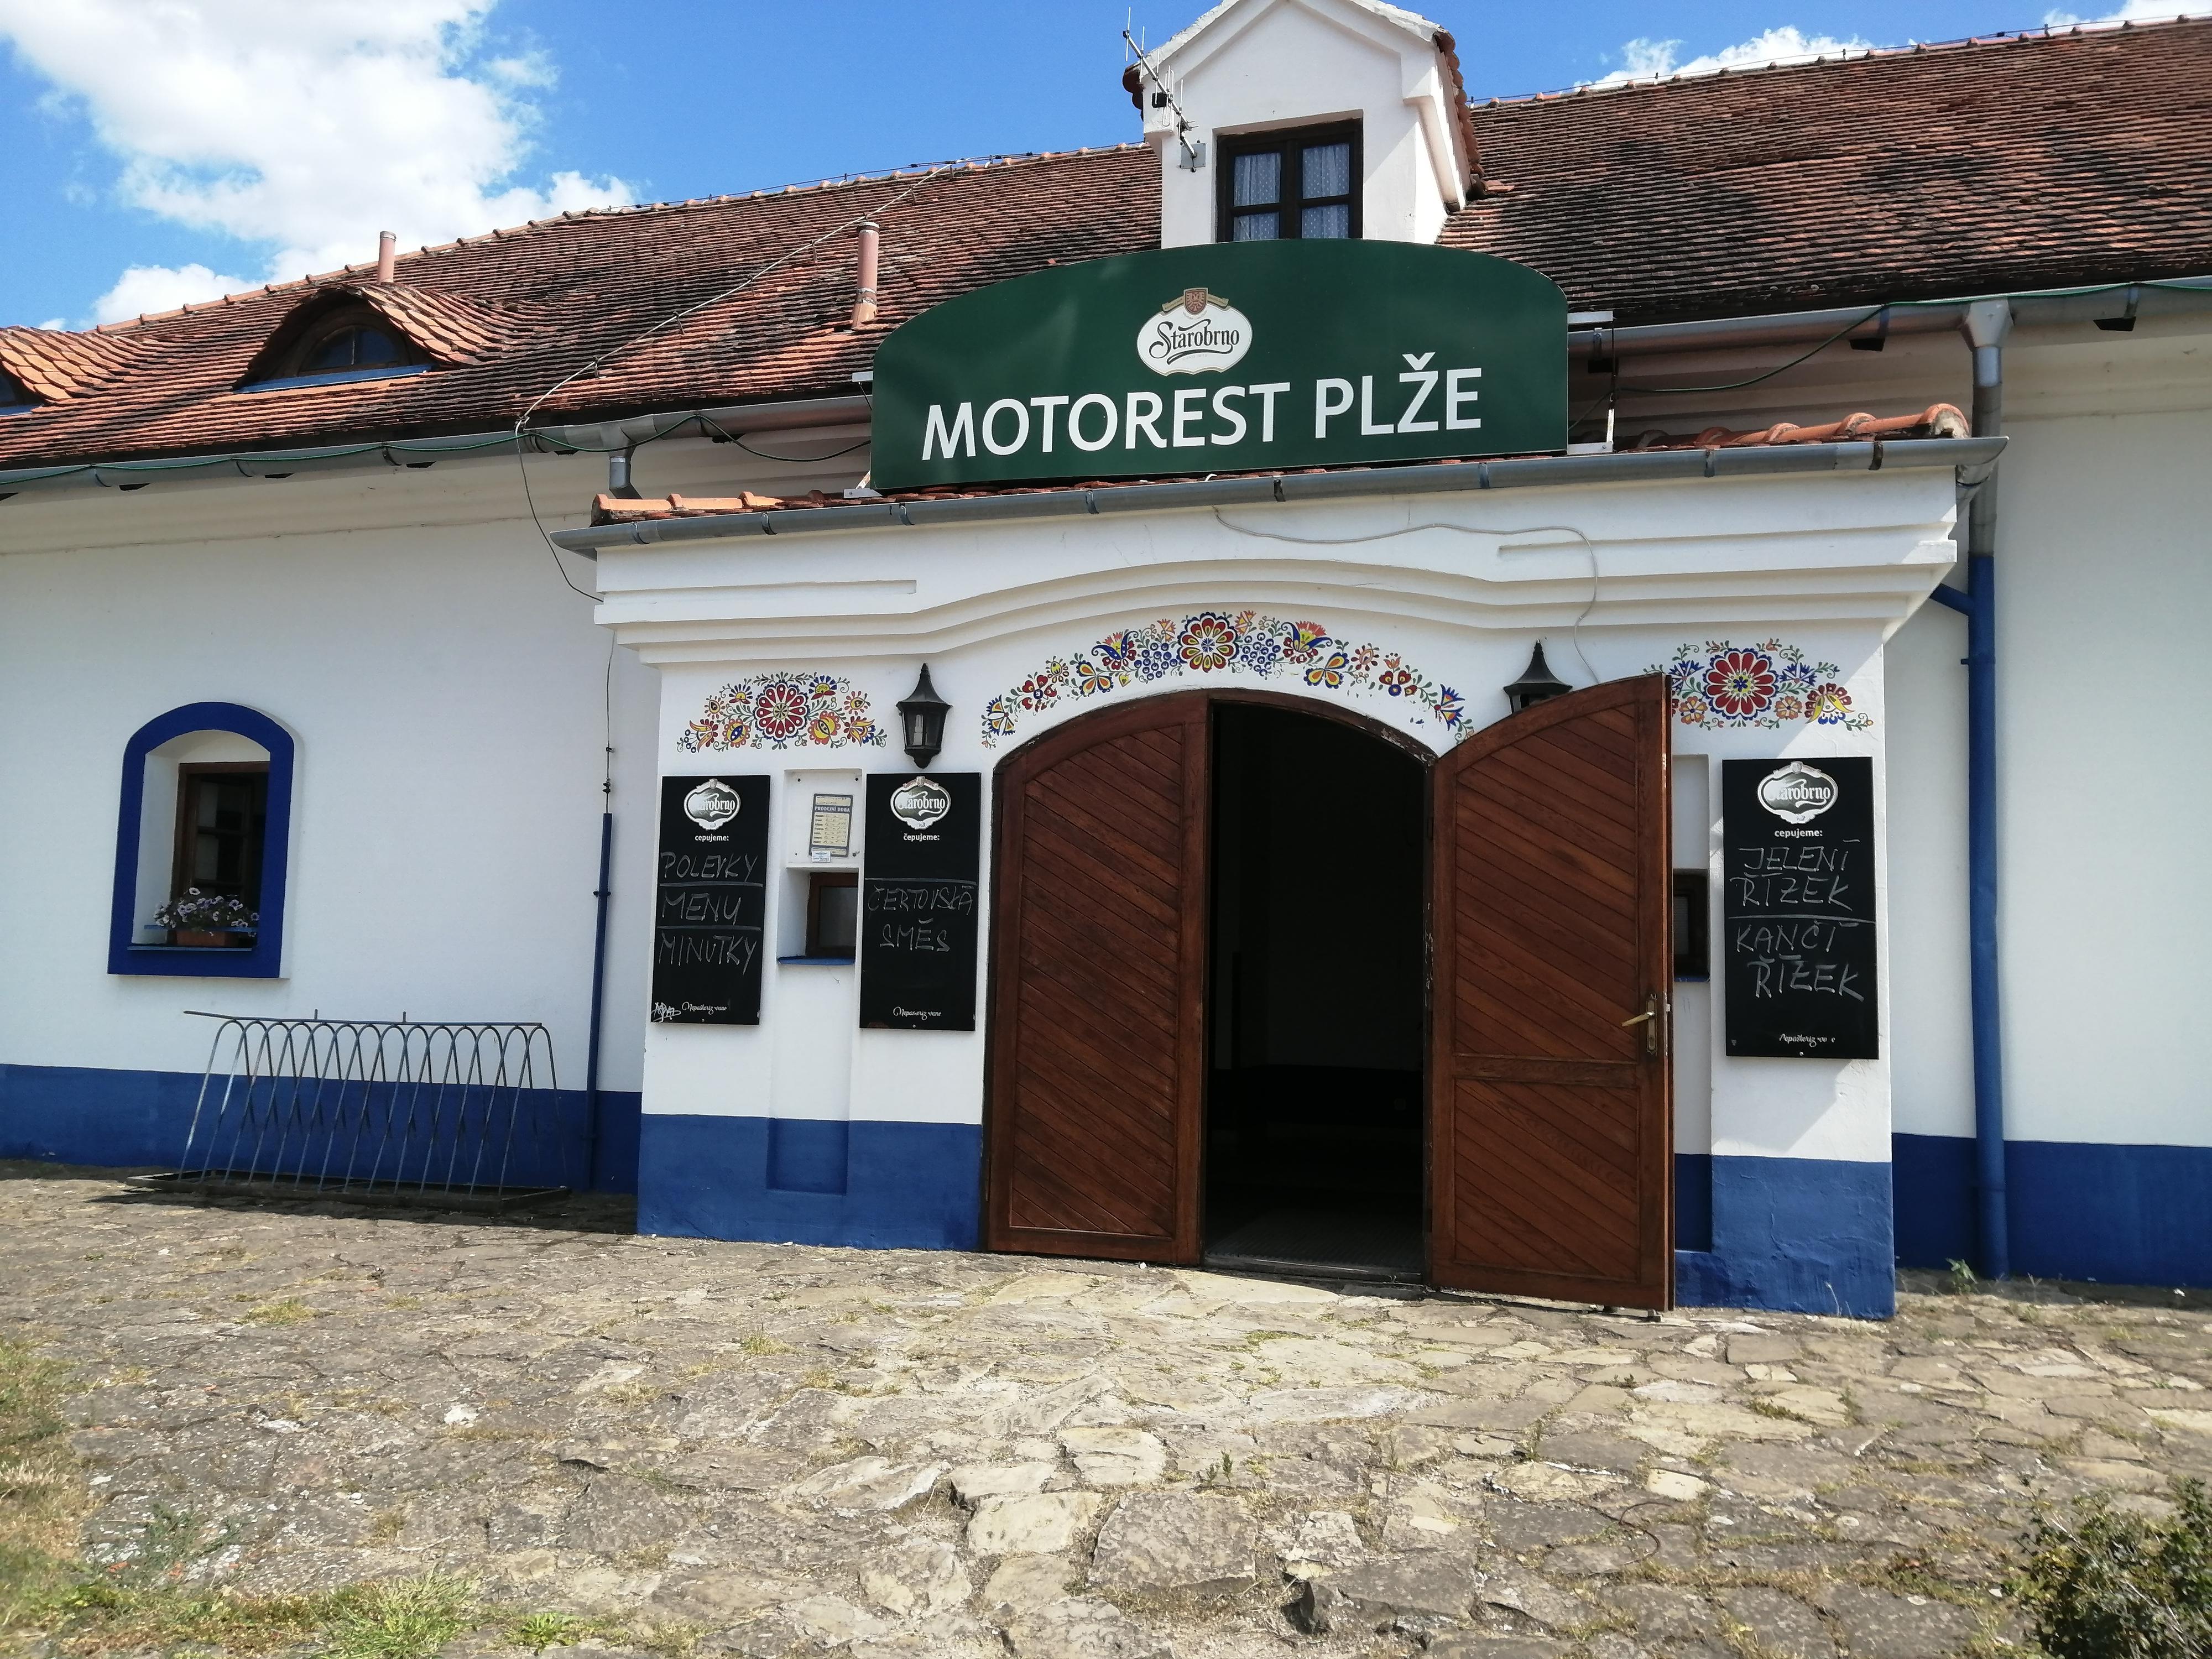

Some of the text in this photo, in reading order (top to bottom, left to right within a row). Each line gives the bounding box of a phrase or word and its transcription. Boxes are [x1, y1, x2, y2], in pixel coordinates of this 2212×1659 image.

[1149, 319, 1240, 365] Starobrno
[921, 352, 1481, 460] MOTOREST PLŽE
[895, 791, 946, 816] arobrno
[1764, 779, 1831, 808] arobrno
[903, 833, 940, 842] čepujeme:
[1738, 839, 1860, 872] JELENÍ
[662, 891, 741, 925] MENU
[1729, 872, 1853, 911] ŘÍZEK
[879, 917, 951, 952] SMĚS
[1736, 920, 1859, 953] KANČÍ
[659, 930, 757, 975] MINUTKY
[1746, 953, 1864, 1003] ŘÍZEK
